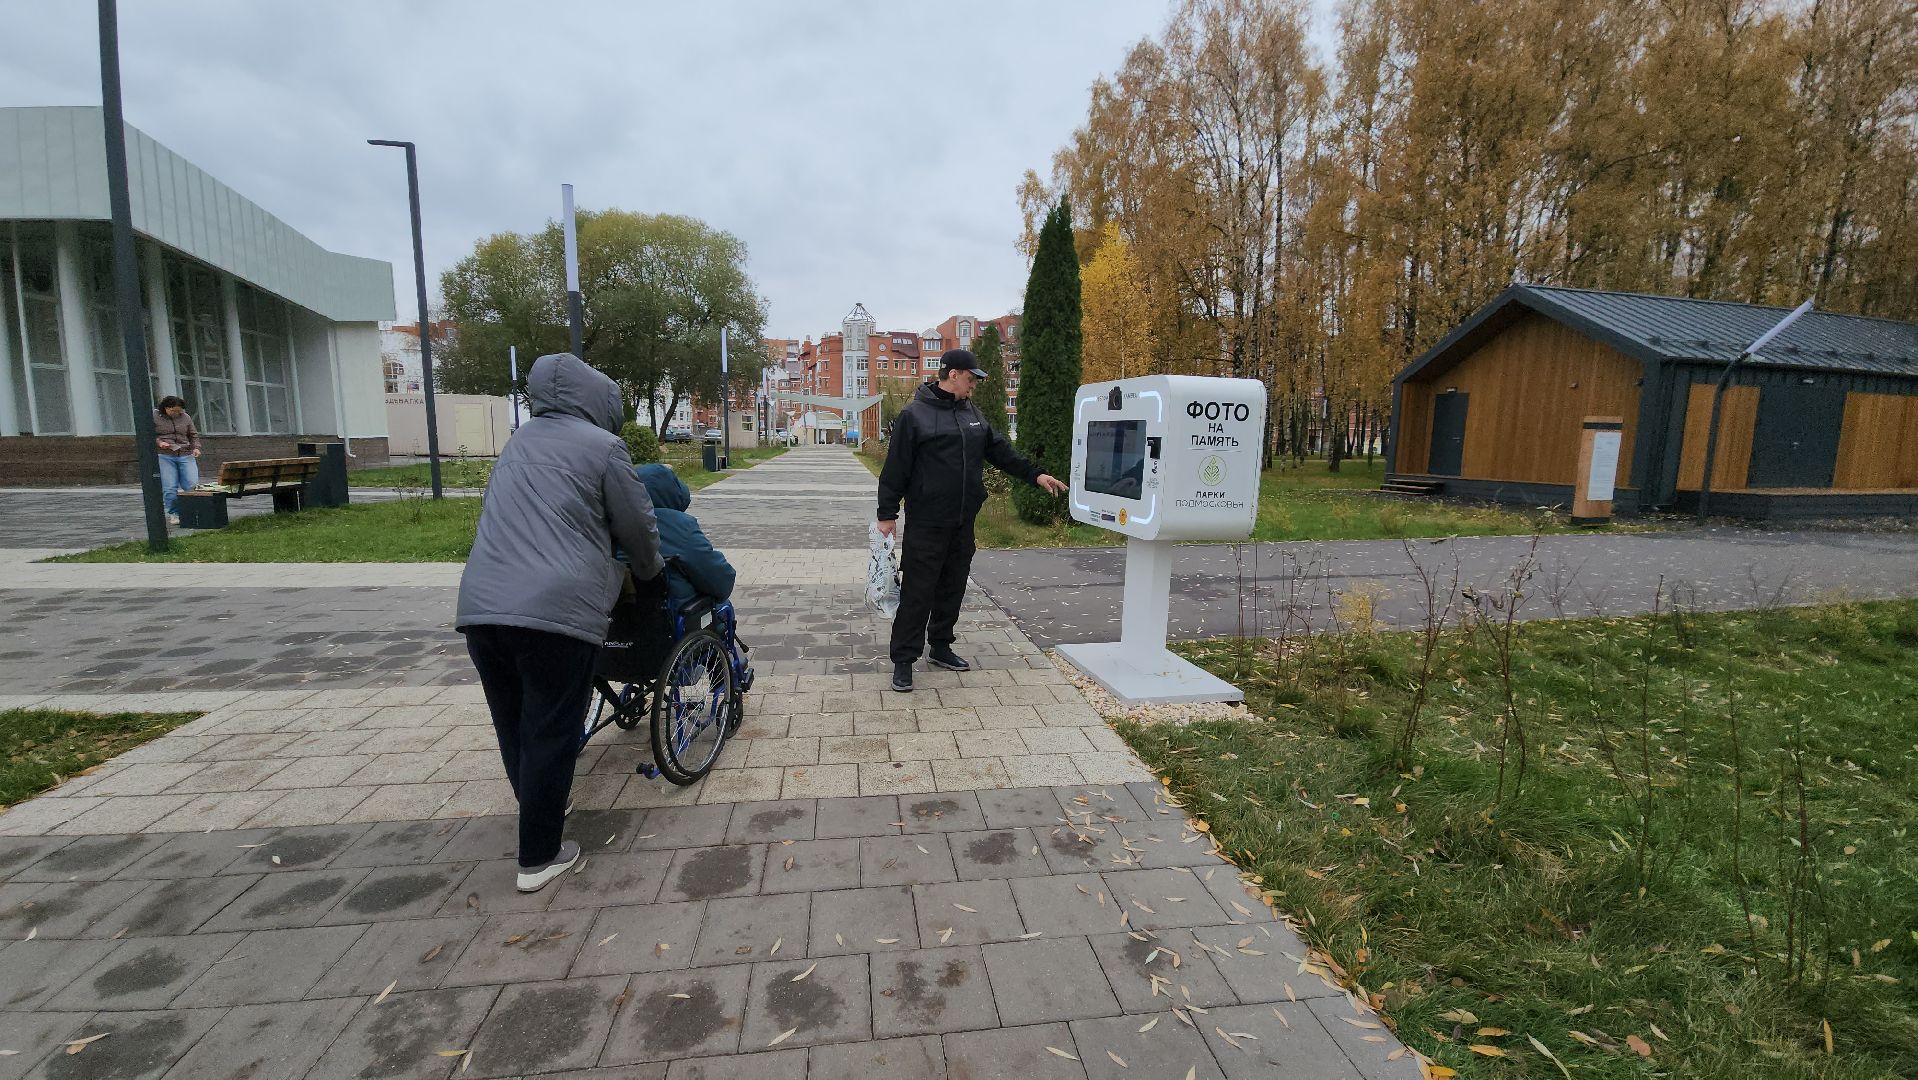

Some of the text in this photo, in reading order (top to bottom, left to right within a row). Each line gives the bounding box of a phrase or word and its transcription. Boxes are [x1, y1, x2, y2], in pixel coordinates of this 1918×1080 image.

[1186, 400, 1250, 422] ФОТО
[1208, 423, 1224, 433] НА
[1191, 435, 1239, 447] ПАМЯТЬ
[1175, 499, 1244, 509] ПОДМОСКОВЬЯ
